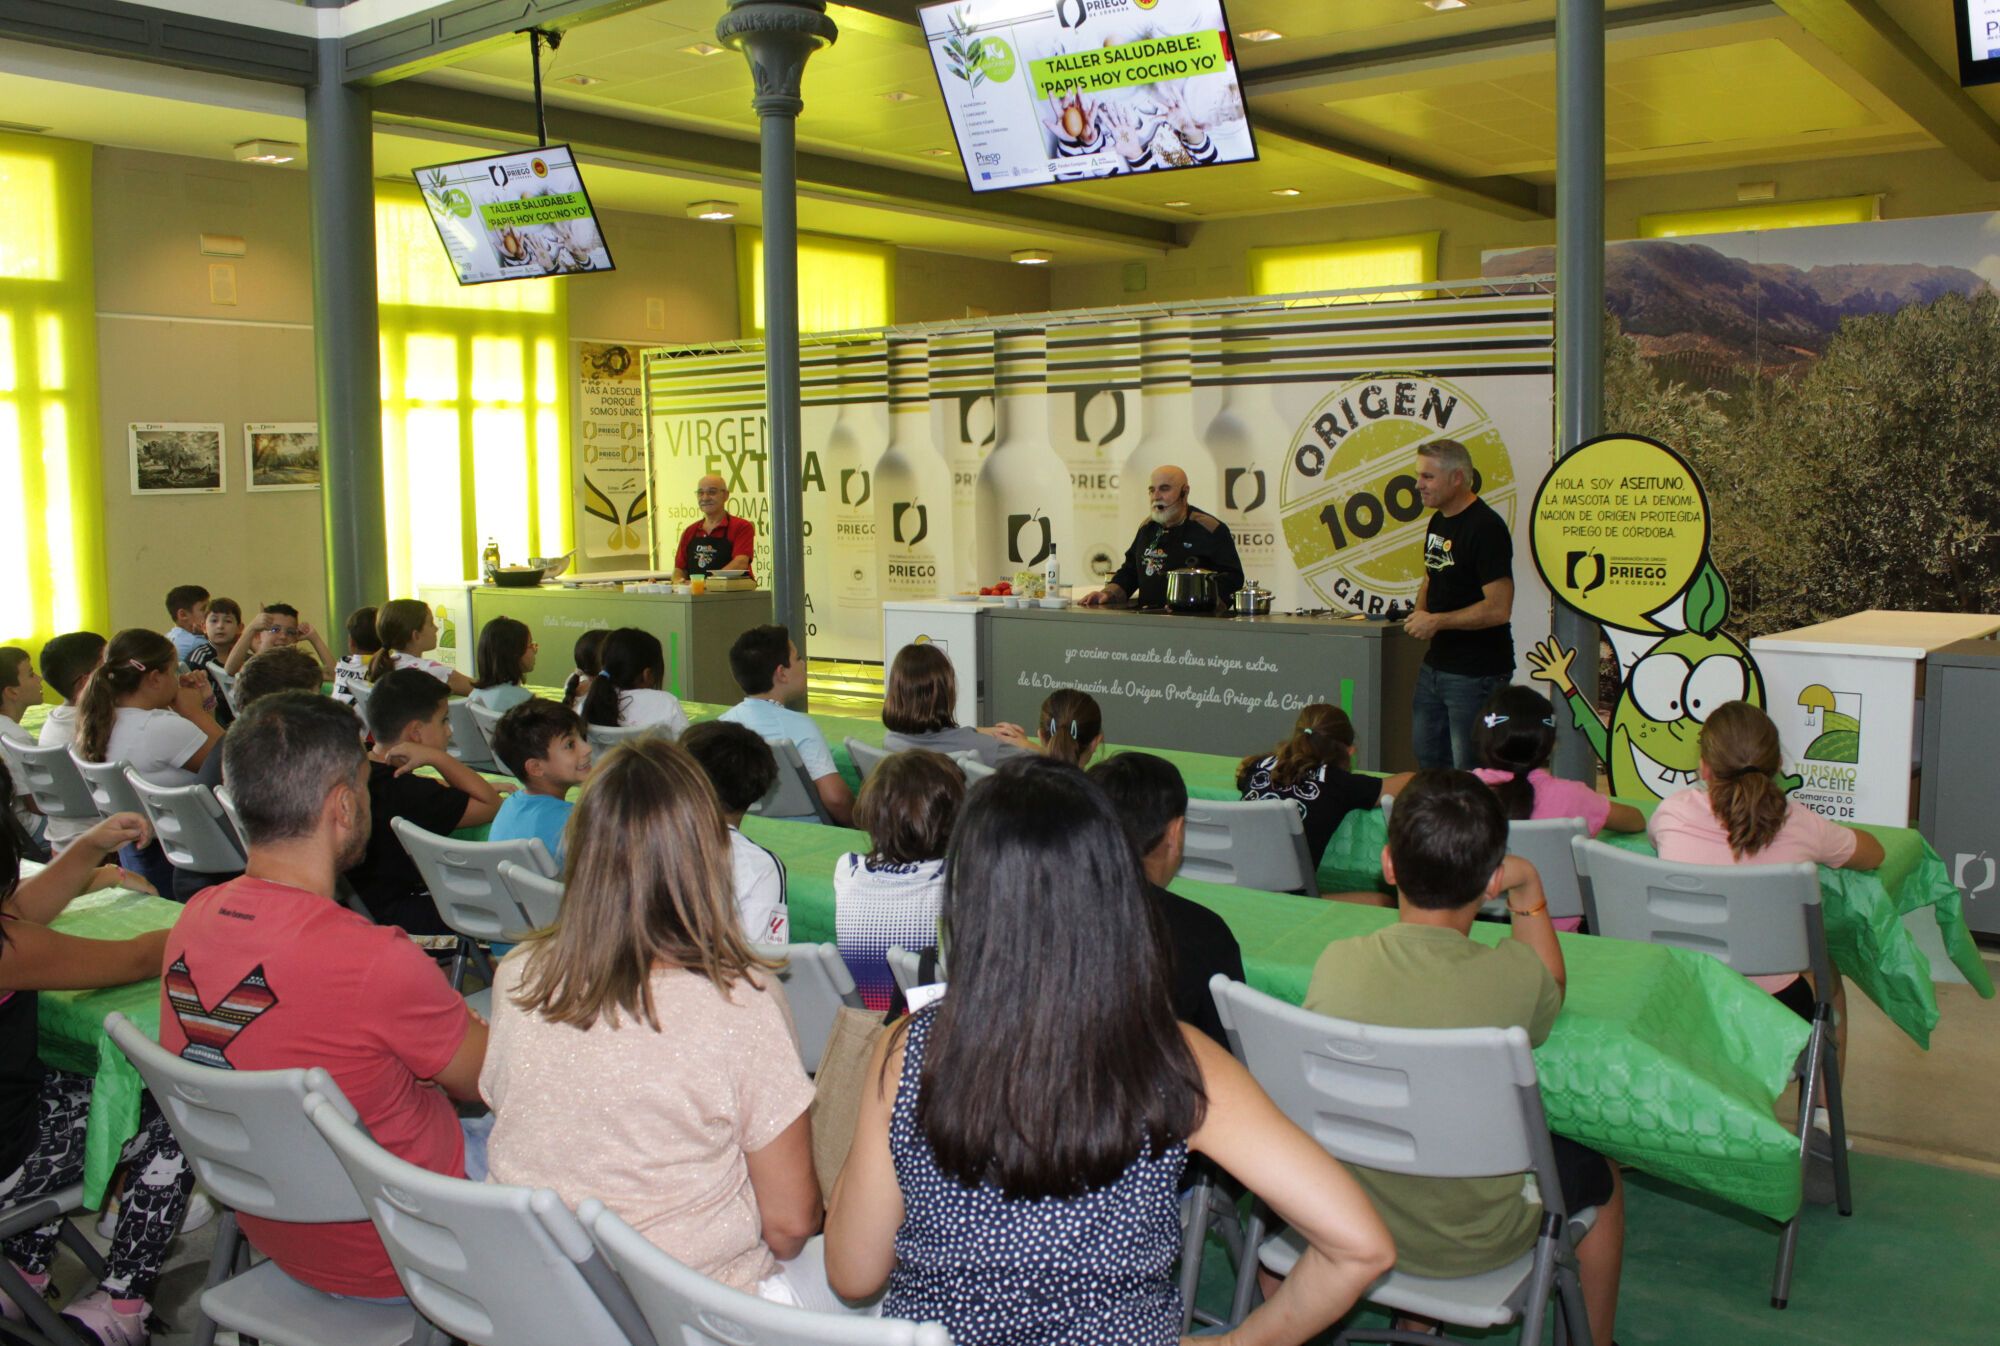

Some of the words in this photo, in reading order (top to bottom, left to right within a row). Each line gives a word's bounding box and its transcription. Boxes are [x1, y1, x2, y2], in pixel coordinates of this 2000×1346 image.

[1046, 54, 1101, 74] TALLER
[1104, 36, 1201, 64] SALUDABLE:
[1091, 71, 1121, 88] HOY
[1126, 60, 1188, 81] COCINO
[489, 203, 521, 214] TALLER
[521, 195, 576, 211] SALUDABLE:
[516, 214, 535, 225] HOY
[536, 209, 571, 221] COCINO
[585, 387, 600, 395] VAS
[602, 387, 609, 395] A
[610, 387, 640, 396] DESCUB
[590, 408, 618, 416] SOMOS
[1295, 382, 1458, 477] ORIGEN
[1555, 478, 1584, 490] HOLA
[1592, 478, 1615, 490] SOY
[1545, 495, 1558, 505] LA
[1563, 494, 1611, 505] MASCOTA
[1615, 495, 1628, 505] DE
[1634, 495, 1647, 505] LA
[1653, 495, 1695, 506] DENOMI-
[1580, 511, 1592, 521] DE
[1597, 510, 1635, 522] ORIGEN
[1641, 511, 1701, 522] PROTEGIDA
[1563, 526, 1601, 537] PRIEGO
[1605, 526, 1619, 537] DE
[889, 564, 936, 577] PRIEGO
[1610, 566, 1667, 579] PRIEGO
[1065, 649, 1078, 664] yo
[1080, 647, 1110, 660] cocino
[1111, 652, 1129, 661] con
[1131, 648, 1162, 664] aceite
[1163, 648, 1177, 665] de
[1178, 649, 1206, 666] oliva
[1207, 655, 1243, 676] virgen
[1245, 656, 1278, 673] extra
[1018, 671, 1031, 686] de
[1031, 672, 1043, 688] la
[1042, 674, 1109, 694] Denominación
[1110, 679, 1124, 695] de
[1125, 681, 1163, 704] Origen
[1165, 684, 1221, 709] Protegida
[1223, 688, 1261, 713] Priego
[1264, 691, 1279, 708] de
[1794, 763, 1857, 780] TURISMO
[1806, 775, 1855, 791] ACEITE
[1792, 791, 1834, 803] Comarca
[1801, 803, 1836, 816] IEGO
[1840, 807, 1855, 818] DE
